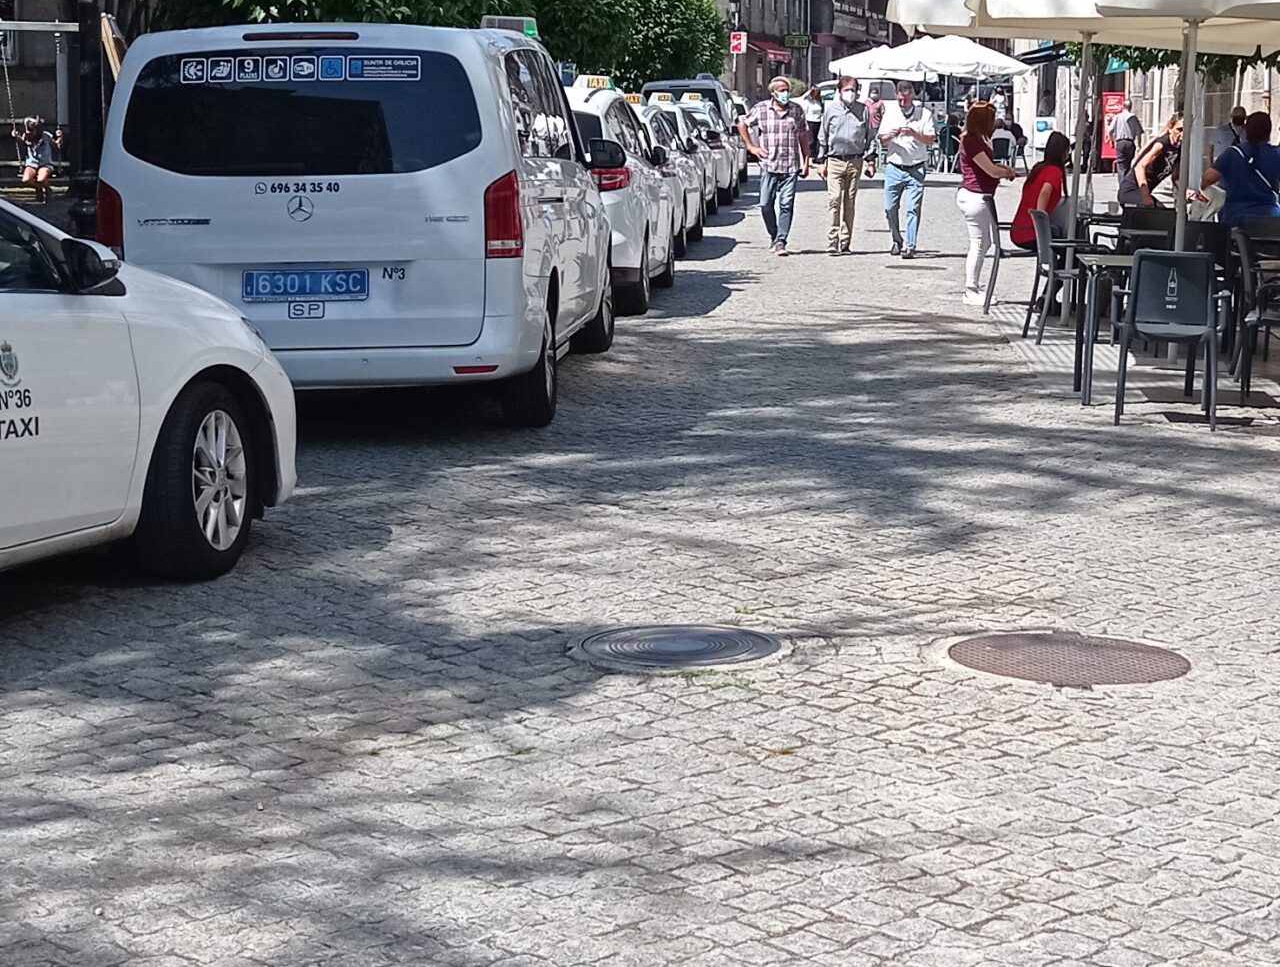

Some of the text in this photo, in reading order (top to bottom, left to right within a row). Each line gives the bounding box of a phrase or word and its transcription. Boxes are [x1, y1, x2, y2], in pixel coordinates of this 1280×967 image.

[244, 59, 254, 73] 9
[588, 77, 607, 88] TAXI
[270, 182, 340, 193] 696 34 35 40
[258, 274, 311, 293] 6301
[321, 273, 361, 292] KSC
[292, 304, 321, 316] SP
[0, 416, 39, 440] TAXI
